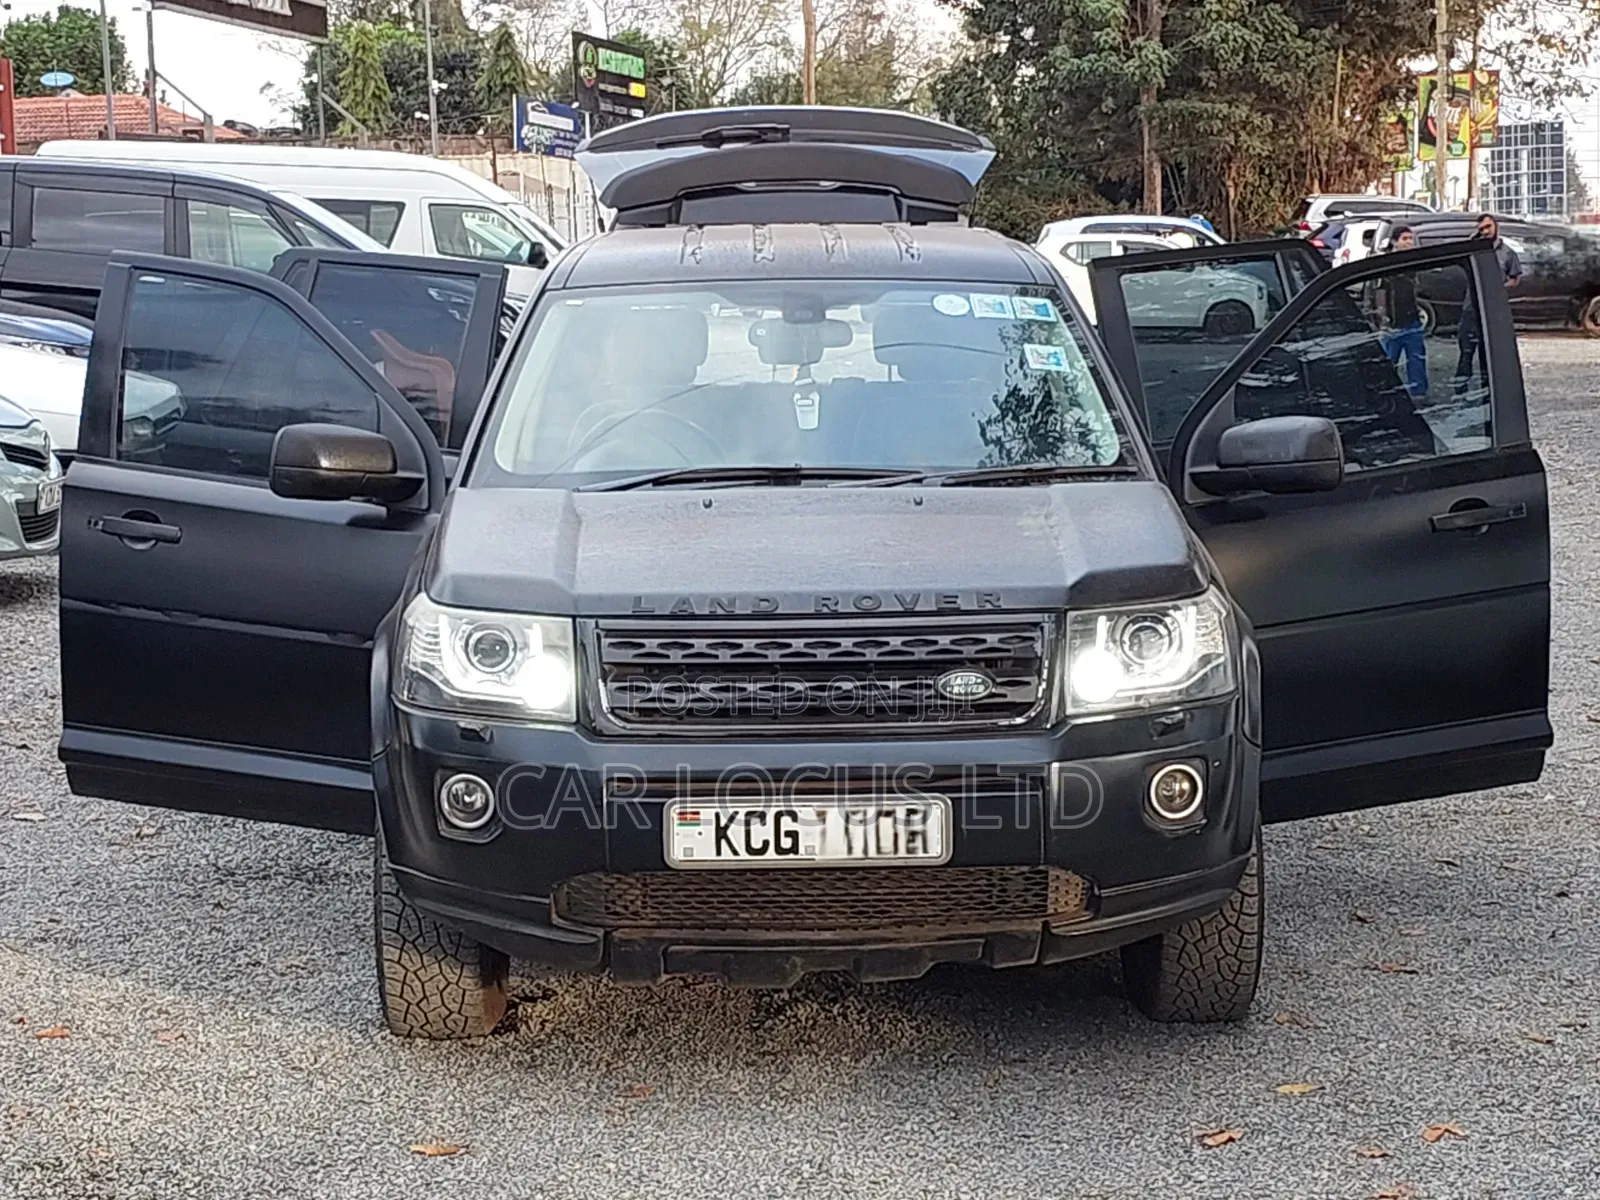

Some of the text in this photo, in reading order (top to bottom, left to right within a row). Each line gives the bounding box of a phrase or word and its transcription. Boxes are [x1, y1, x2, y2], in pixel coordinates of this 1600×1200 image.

[632, 591, 1002, 614] LAND ROVER
[714, 809, 800, 857] KCG
